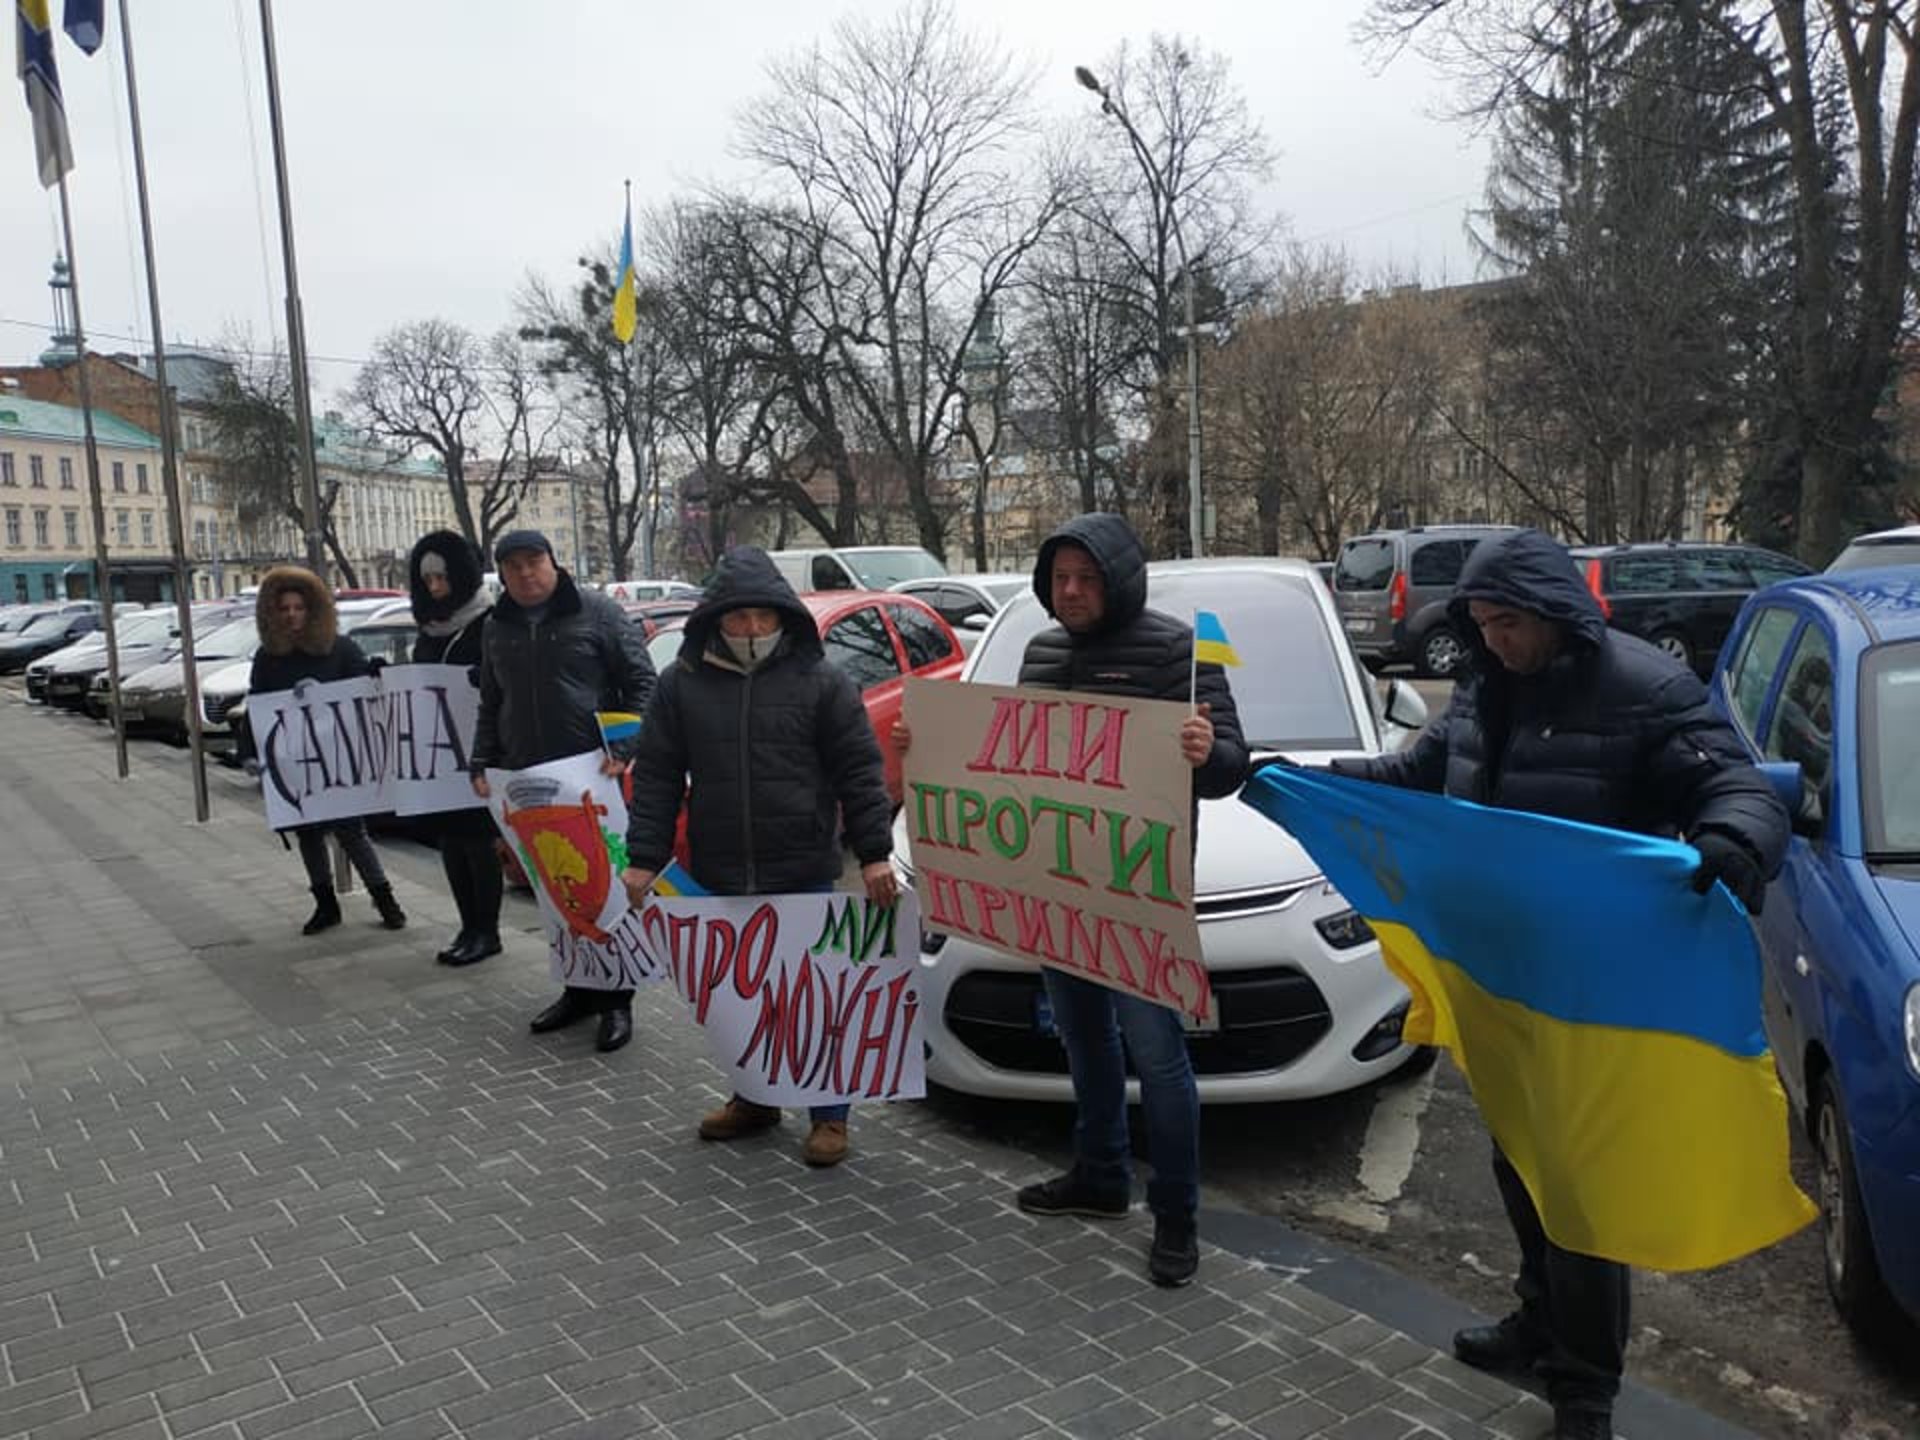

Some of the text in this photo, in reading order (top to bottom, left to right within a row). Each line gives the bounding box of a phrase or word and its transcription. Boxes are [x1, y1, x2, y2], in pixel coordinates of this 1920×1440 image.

[965, 696, 1131, 789] МИ
[909, 782, 1187, 910] ПРОТИ
[810, 896, 897, 967] МИ
[917, 866, 1212, 1020] ПРИМУСУ
[736, 949, 920, 1098] МОЖНІ
